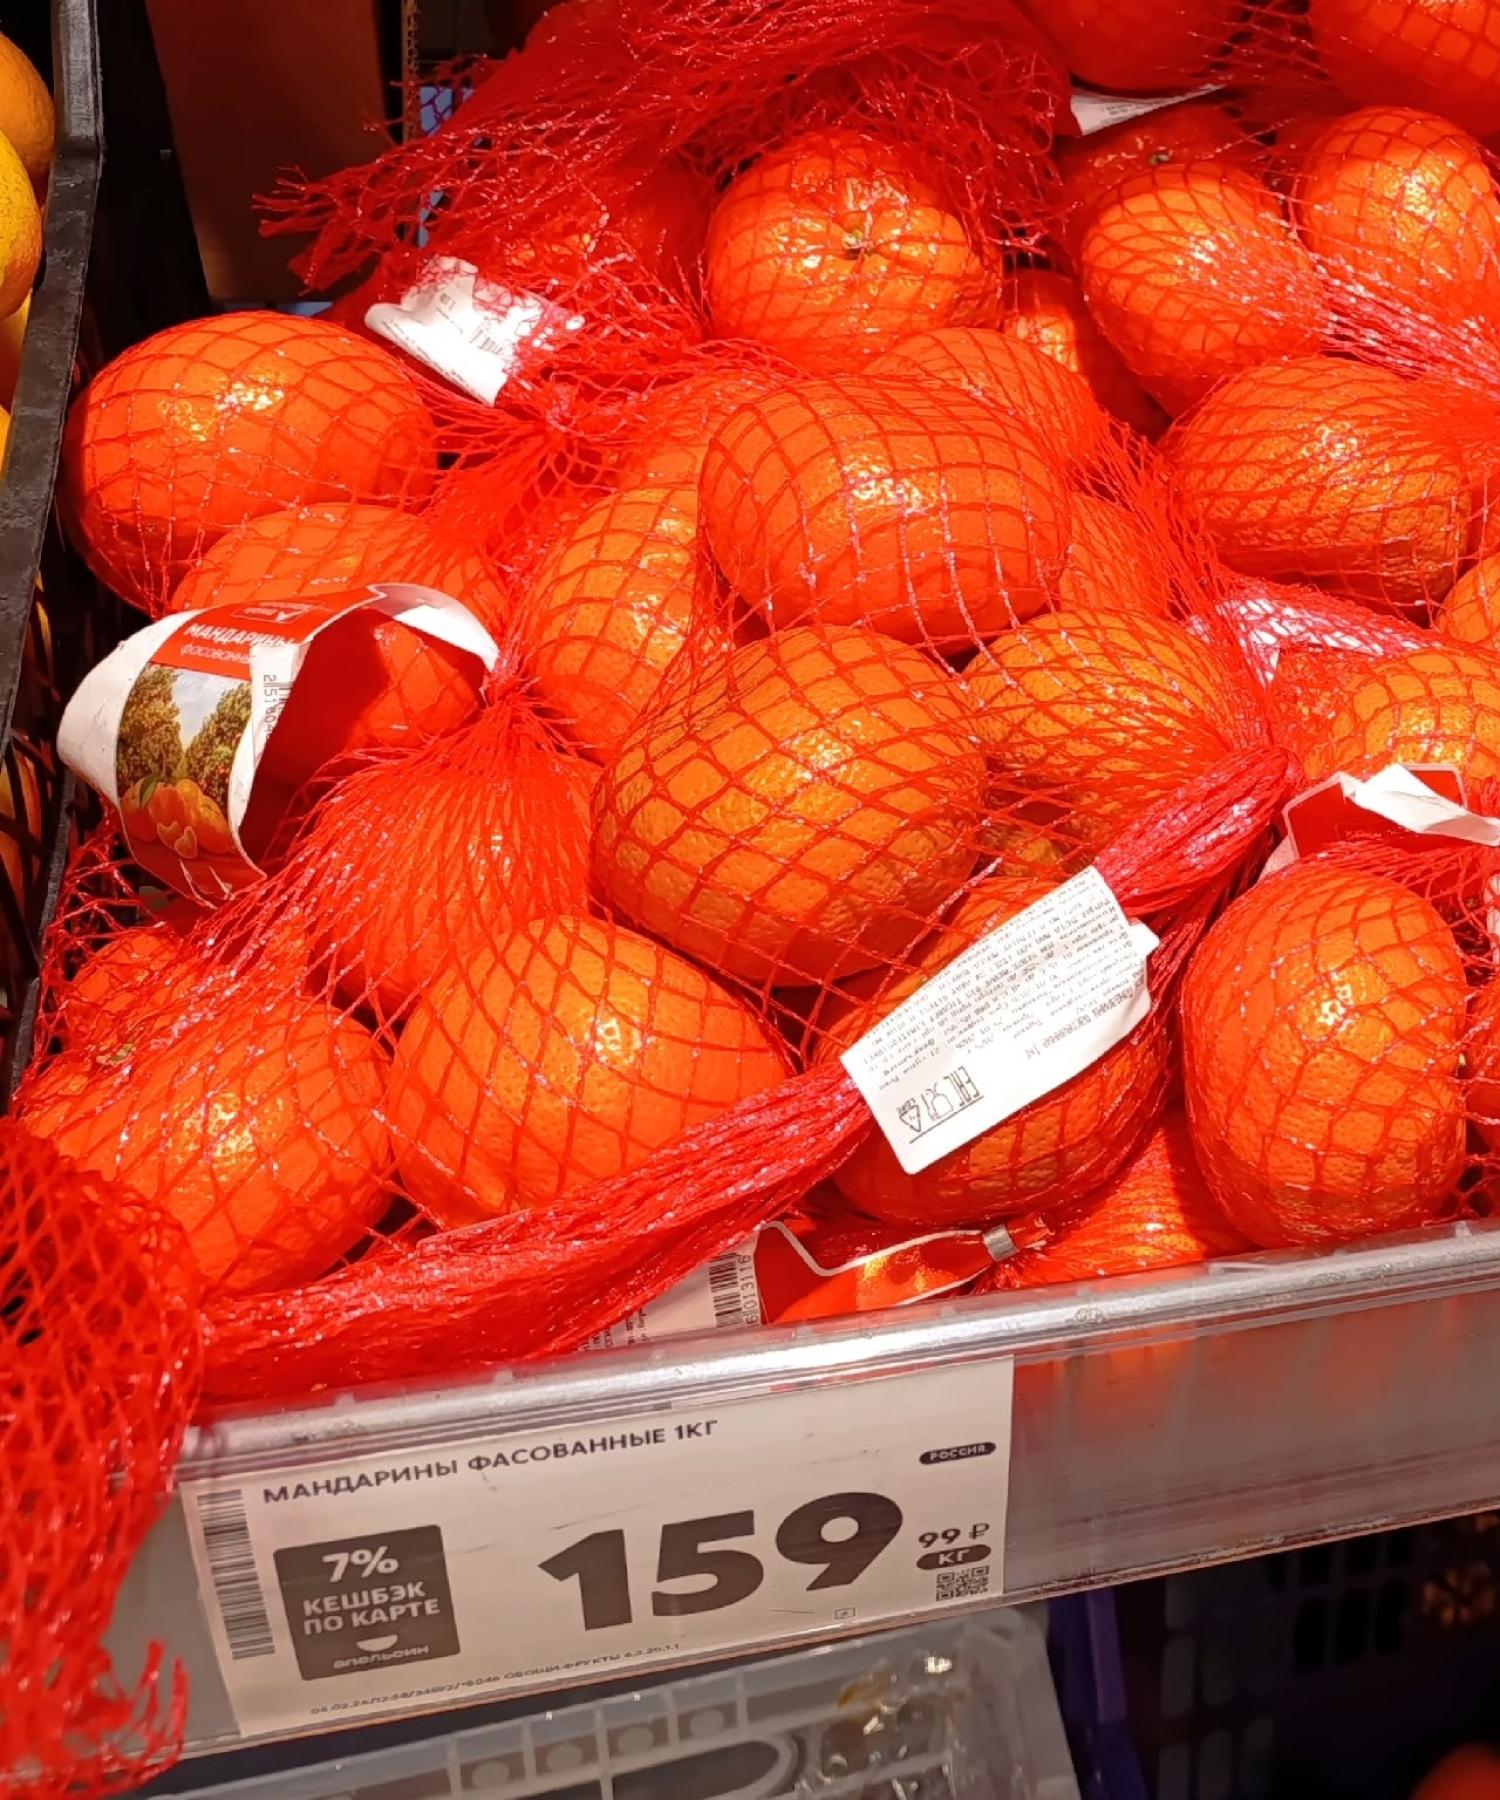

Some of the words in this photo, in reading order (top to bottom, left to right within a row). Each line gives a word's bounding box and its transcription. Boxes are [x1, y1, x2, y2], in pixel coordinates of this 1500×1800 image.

[264, 1459, 457, 1503] МАНДАРИНЫ
[468, 1429, 665, 1472] ФАСОВАННЫЕ
[675, 1420, 718, 1441] 1КГ
[930, 1445, 985, 1462] РОССИЯ
[918, 1528, 960, 1548] 99
[322, 1546, 399, 1582] 7%
[537, 1492, 903, 1630] 159
[938, 1549, 970, 1565] КГ
[303, 1581, 426, 1616] КЕШБЭК
[303, 1615, 344, 1636] ПО
[351, 1598, 440, 1629] КАРТЕ
[334, 1646, 430, 1669] апельсин
